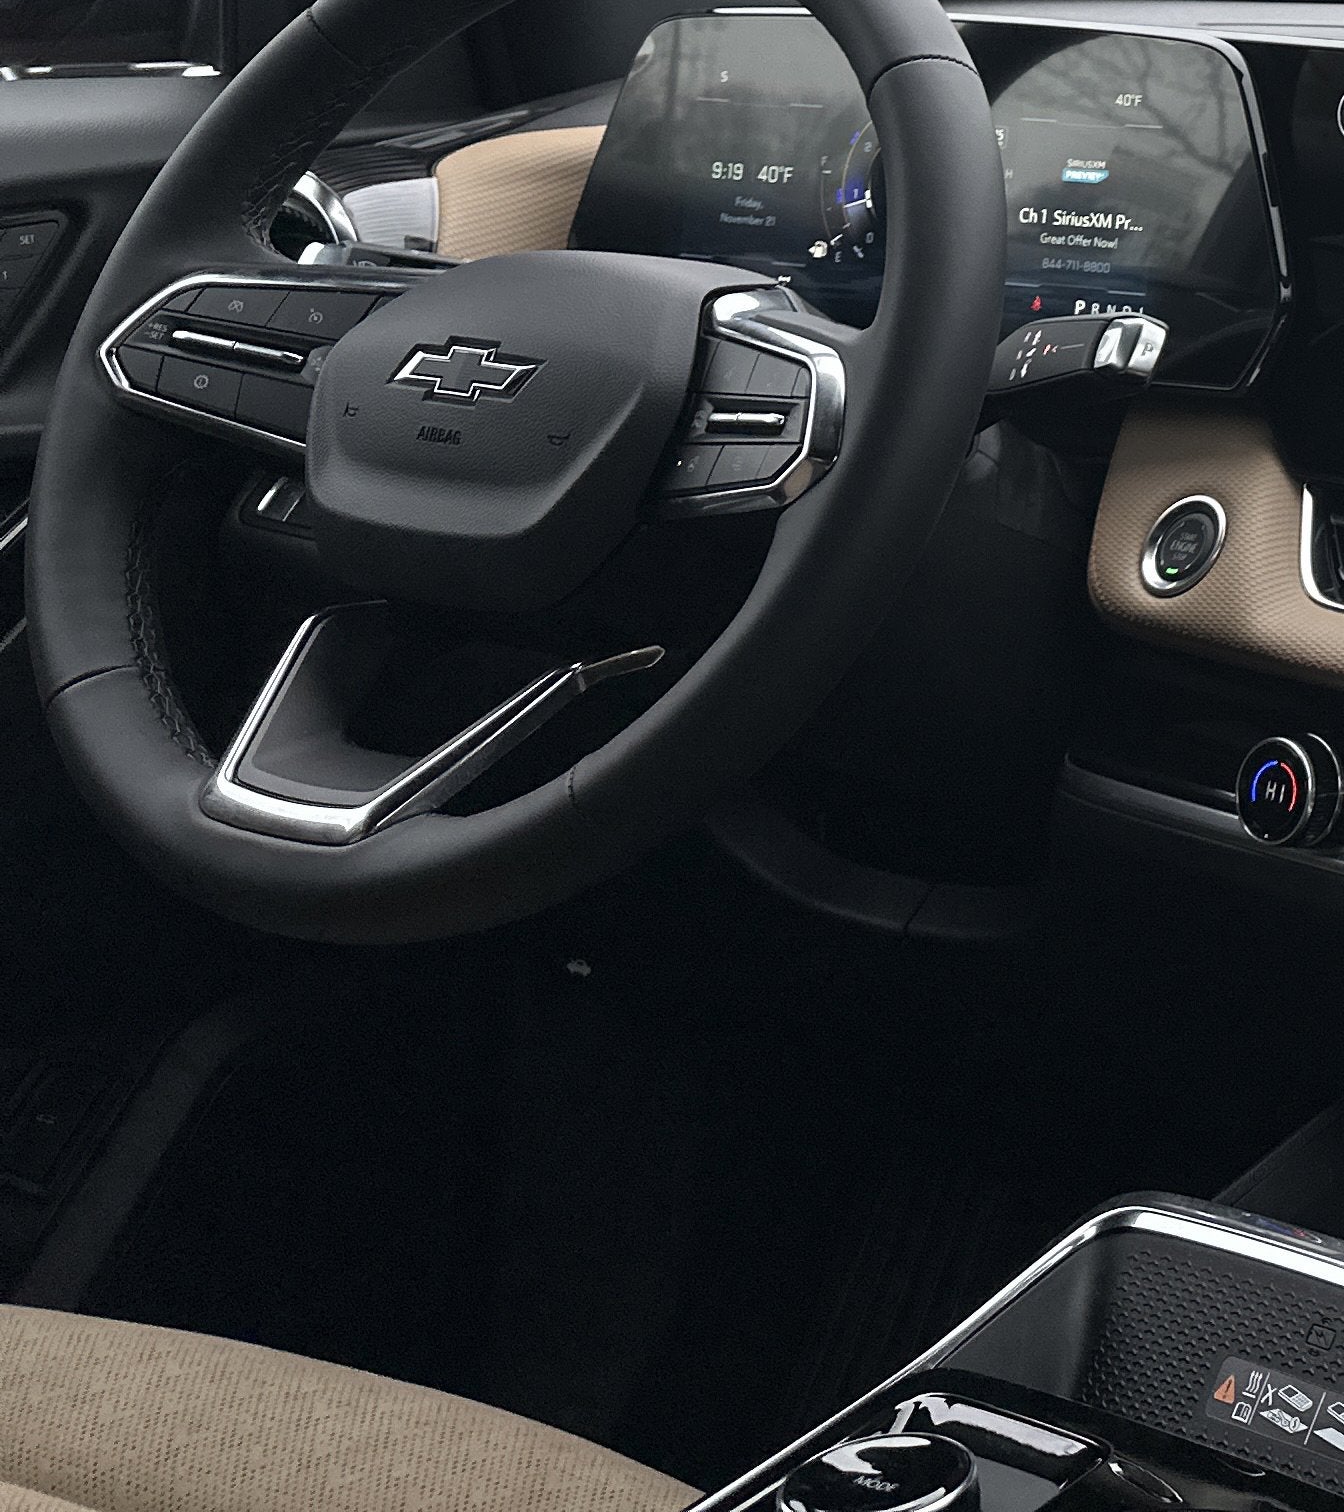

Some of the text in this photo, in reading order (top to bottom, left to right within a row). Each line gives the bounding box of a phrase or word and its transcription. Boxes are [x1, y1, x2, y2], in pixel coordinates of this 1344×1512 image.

[719, 70, 729, 83] S
[711, 161, 794, 184] 9:19 40°F
[719, 213, 764, 226] November
[1019, 207, 1143, 232] Ch 1 SiriusXM Pr...
[19, 234, 35, 245] SET
[1040, 233, 1118, 249] Great Offer Now!
[834, 250, 842, 263] E
[1042, 257, 1111, 273] 844-711-8800
[1074, 300, 1086, 314] P
[416, 425, 462, 446] AIRBAG
[1169, 539, 1198, 554] ENGINE
[1264, 779, 1286, 804] HI
